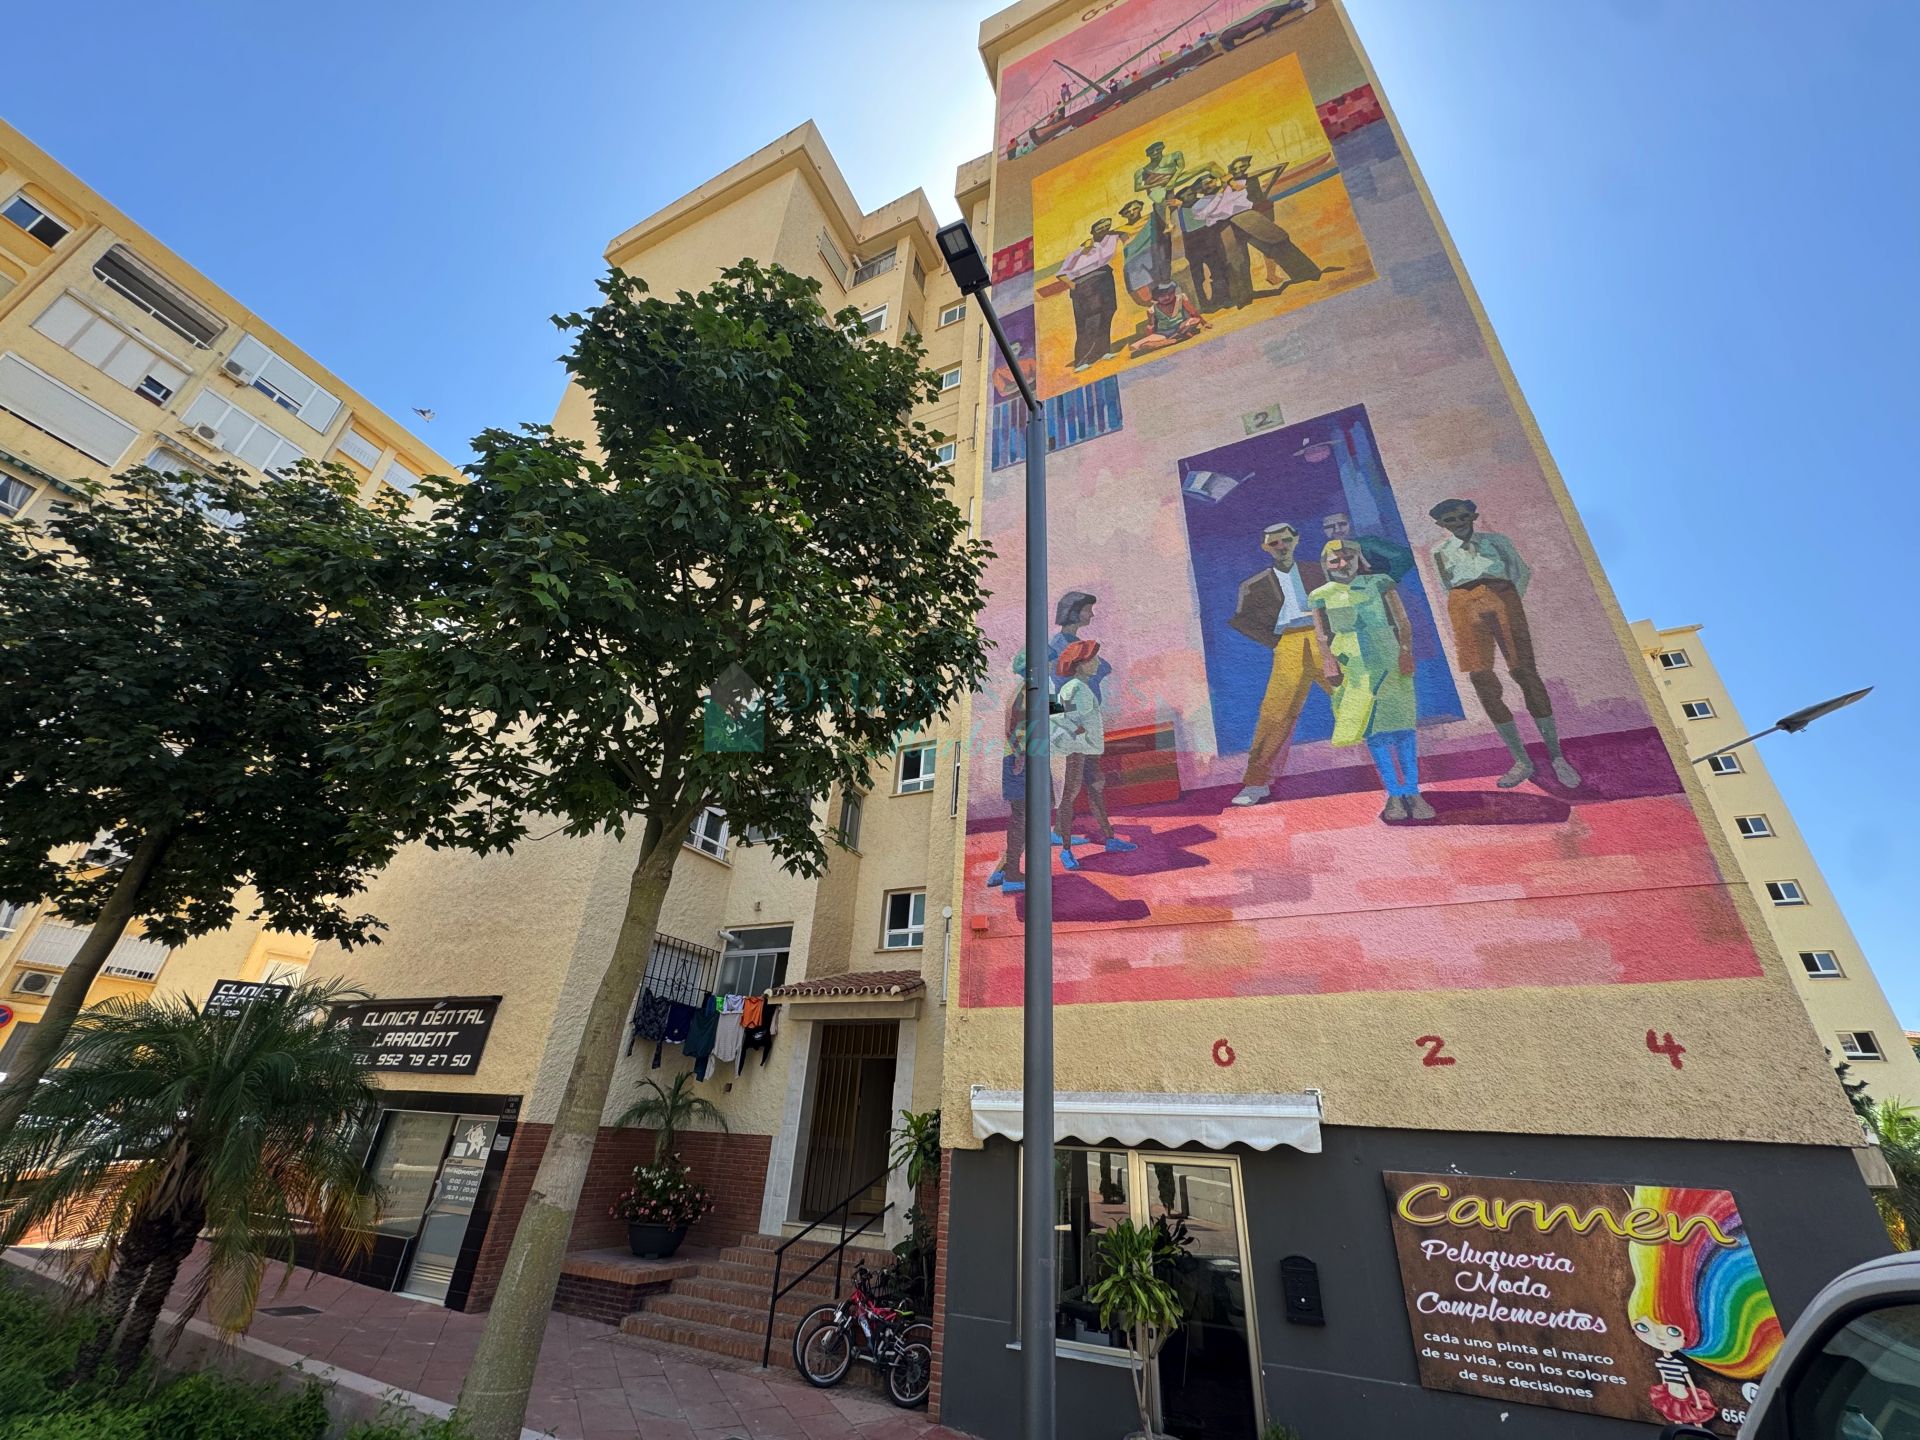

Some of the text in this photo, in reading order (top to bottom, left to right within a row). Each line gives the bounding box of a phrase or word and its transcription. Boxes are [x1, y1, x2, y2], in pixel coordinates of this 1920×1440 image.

[1253, 411, 1273, 428] 2
[362, 1009, 486, 1027] CLINICA DENTAL
[376, 1053, 403, 1066] 952
[409, 1054, 425, 1066] 79
[427, 1054, 448, 1066] 27
[450, 1054, 471, 1067] 50
[1415, 1035, 1456, 1067] 2
[1646, 1029, 1686, 1070] 4
[1399, 1183, 1737, 1246] Carmen
[1420, 1239, 1575, 1273] Peluquería
[1455, 1271, 1551, 1299] Moda
[1417, 1291, 1608, 1334] Complementos
[1423, 1331, 1614, 1366] cada uno pinta el marco
[1421, 1347, 1628, 1386] de su vida, con los colores
[1459, 1369, 1594, 1399] de sus decisiones
